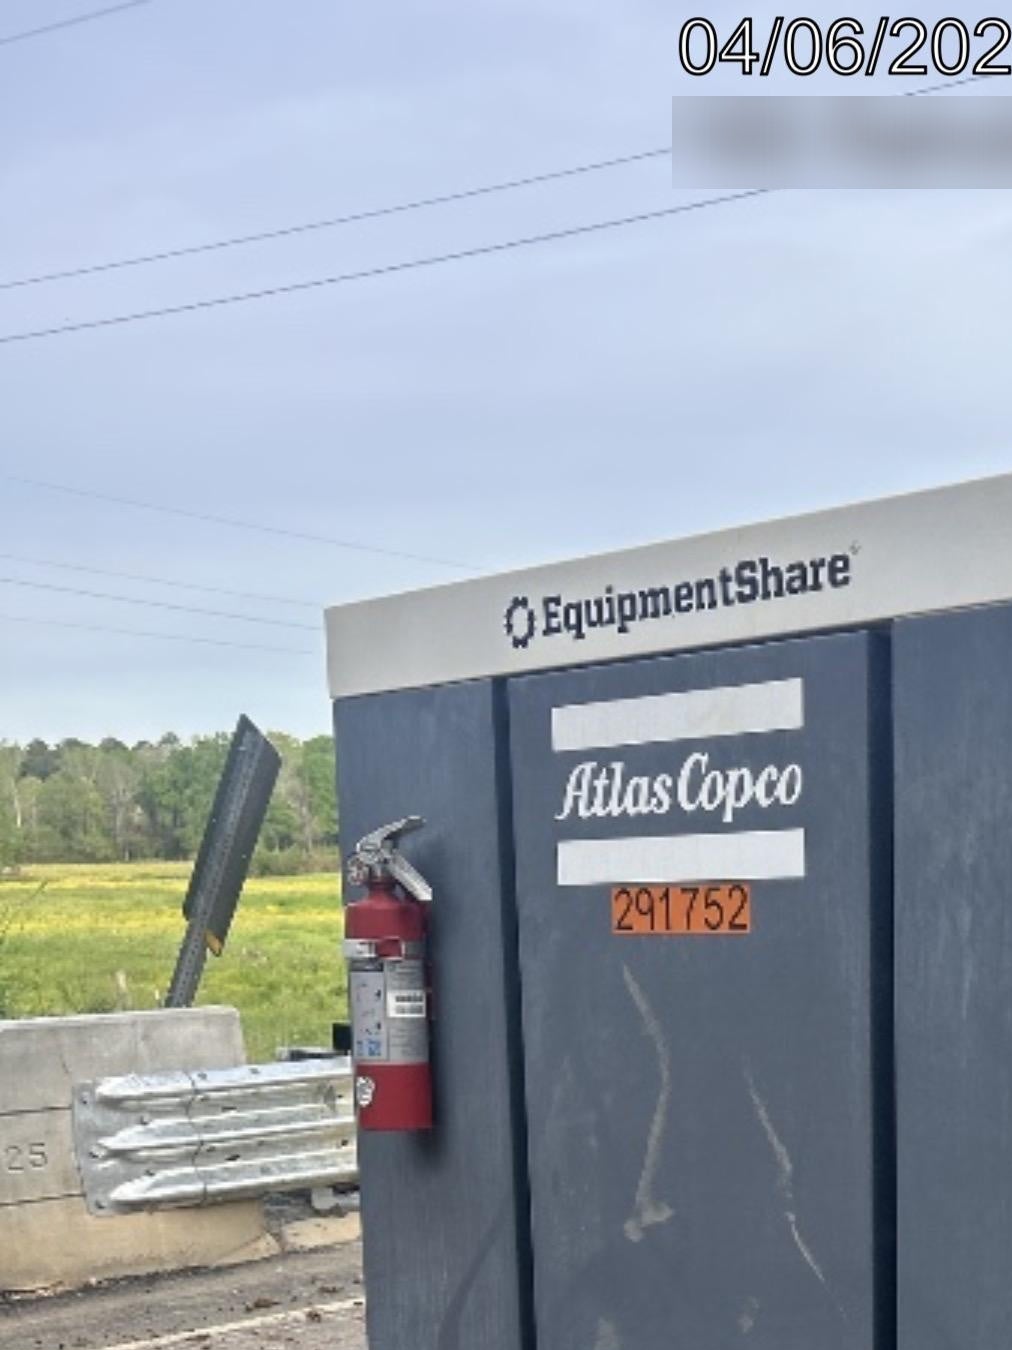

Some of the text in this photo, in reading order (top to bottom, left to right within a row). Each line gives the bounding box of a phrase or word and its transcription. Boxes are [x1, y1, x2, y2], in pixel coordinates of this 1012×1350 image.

[542, 553, 850, 639] EquipmentShare
[554, 752, 802, 822] Atlas Copco
[614, 885, 748, 930] 291752
[4, 1143, 48, 1172] 25
